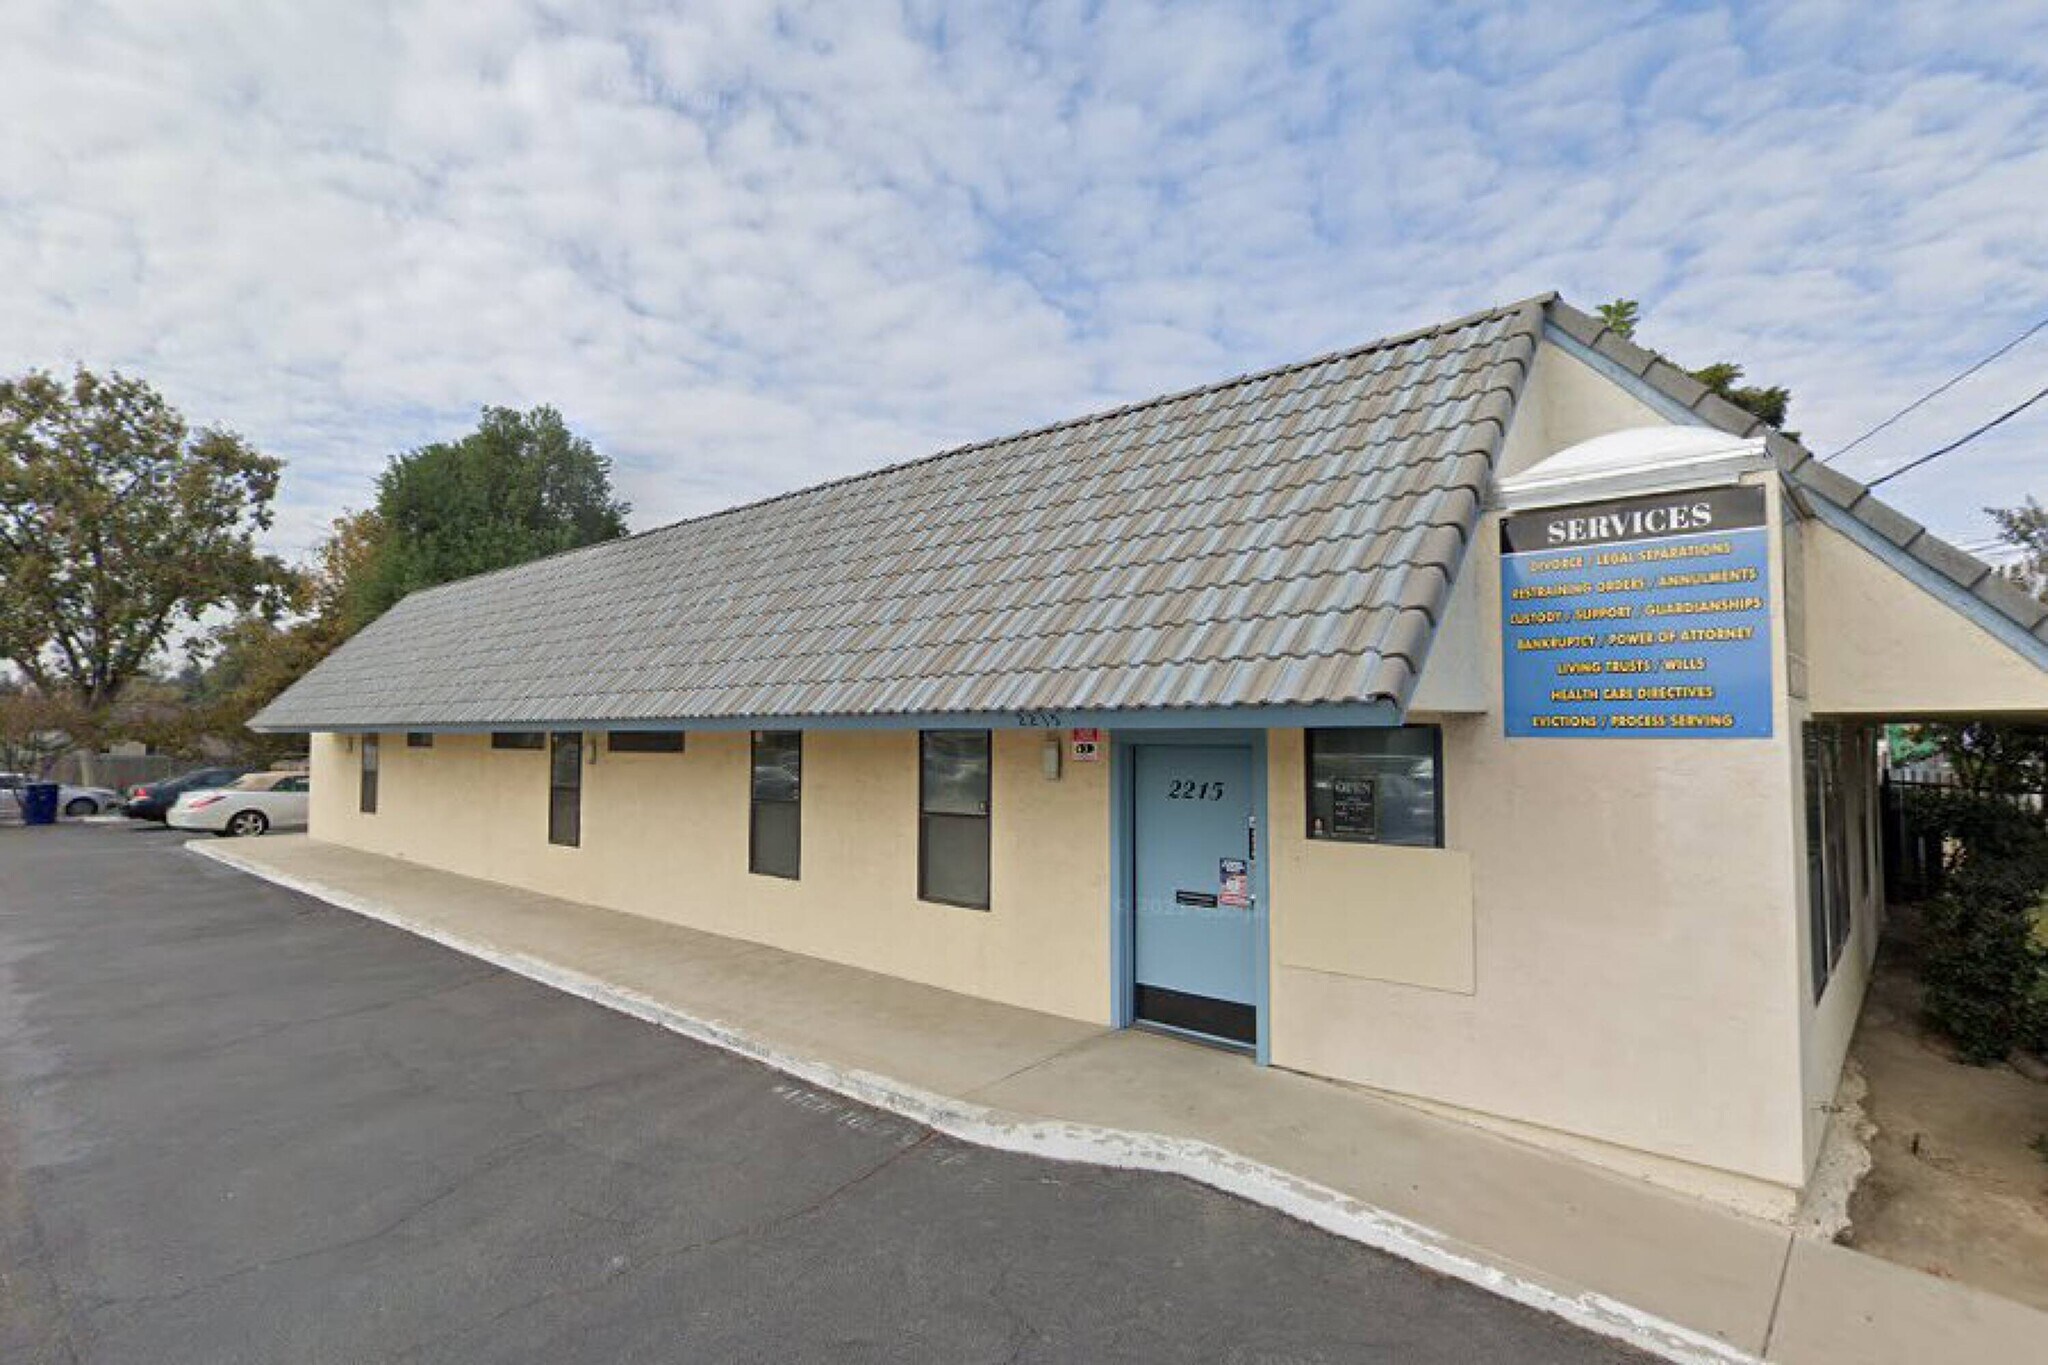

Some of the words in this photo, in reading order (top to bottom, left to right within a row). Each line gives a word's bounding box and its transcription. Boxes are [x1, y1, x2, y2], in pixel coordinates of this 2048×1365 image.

[1547, 502, 1712, 544] SERVICES
[1529, 556, 1583, 572] DIVORCE
[1597, 551, 1634, 566] LEGAL
[1638, 542, 1731, 561] SEPARATIONS
[1512, 582, 1592, 600] RESTRAINING
[1597, 577, 1644, 594] ORDERS
[1510, 610, 1563, 625] CUSTODY
[1574, 605, 1632, 621] SUPPORT
[1645, 597, 1763, 616] GUARDIANSHIPS
[1517, 635, 1597, 651] BANKRUPTCY
[1608, 631, 1654, 646] POWER
[1658, 628, 1676, 643] OF
[1681, 625, 1754, 642] ATTORNEY
[1557, 661, 1603, 676] LIVING
[1605, 659, 1651, 674] TRUSTS
[1664, 657, 1706, 671] WILLS
[1551, 688, 1599, 702] HEALTH
[1603, 687, 1634, 701] CARE
[1638, 685, 1715, 701] DIRECTIVES
[1532, 715, 1598, 729] EVICTIONS
[1611, 714, 1666, 729] PROCESS
[1670, 713, 1735, 729] SERVING
[1168, 779, 1225, 801] 2215
